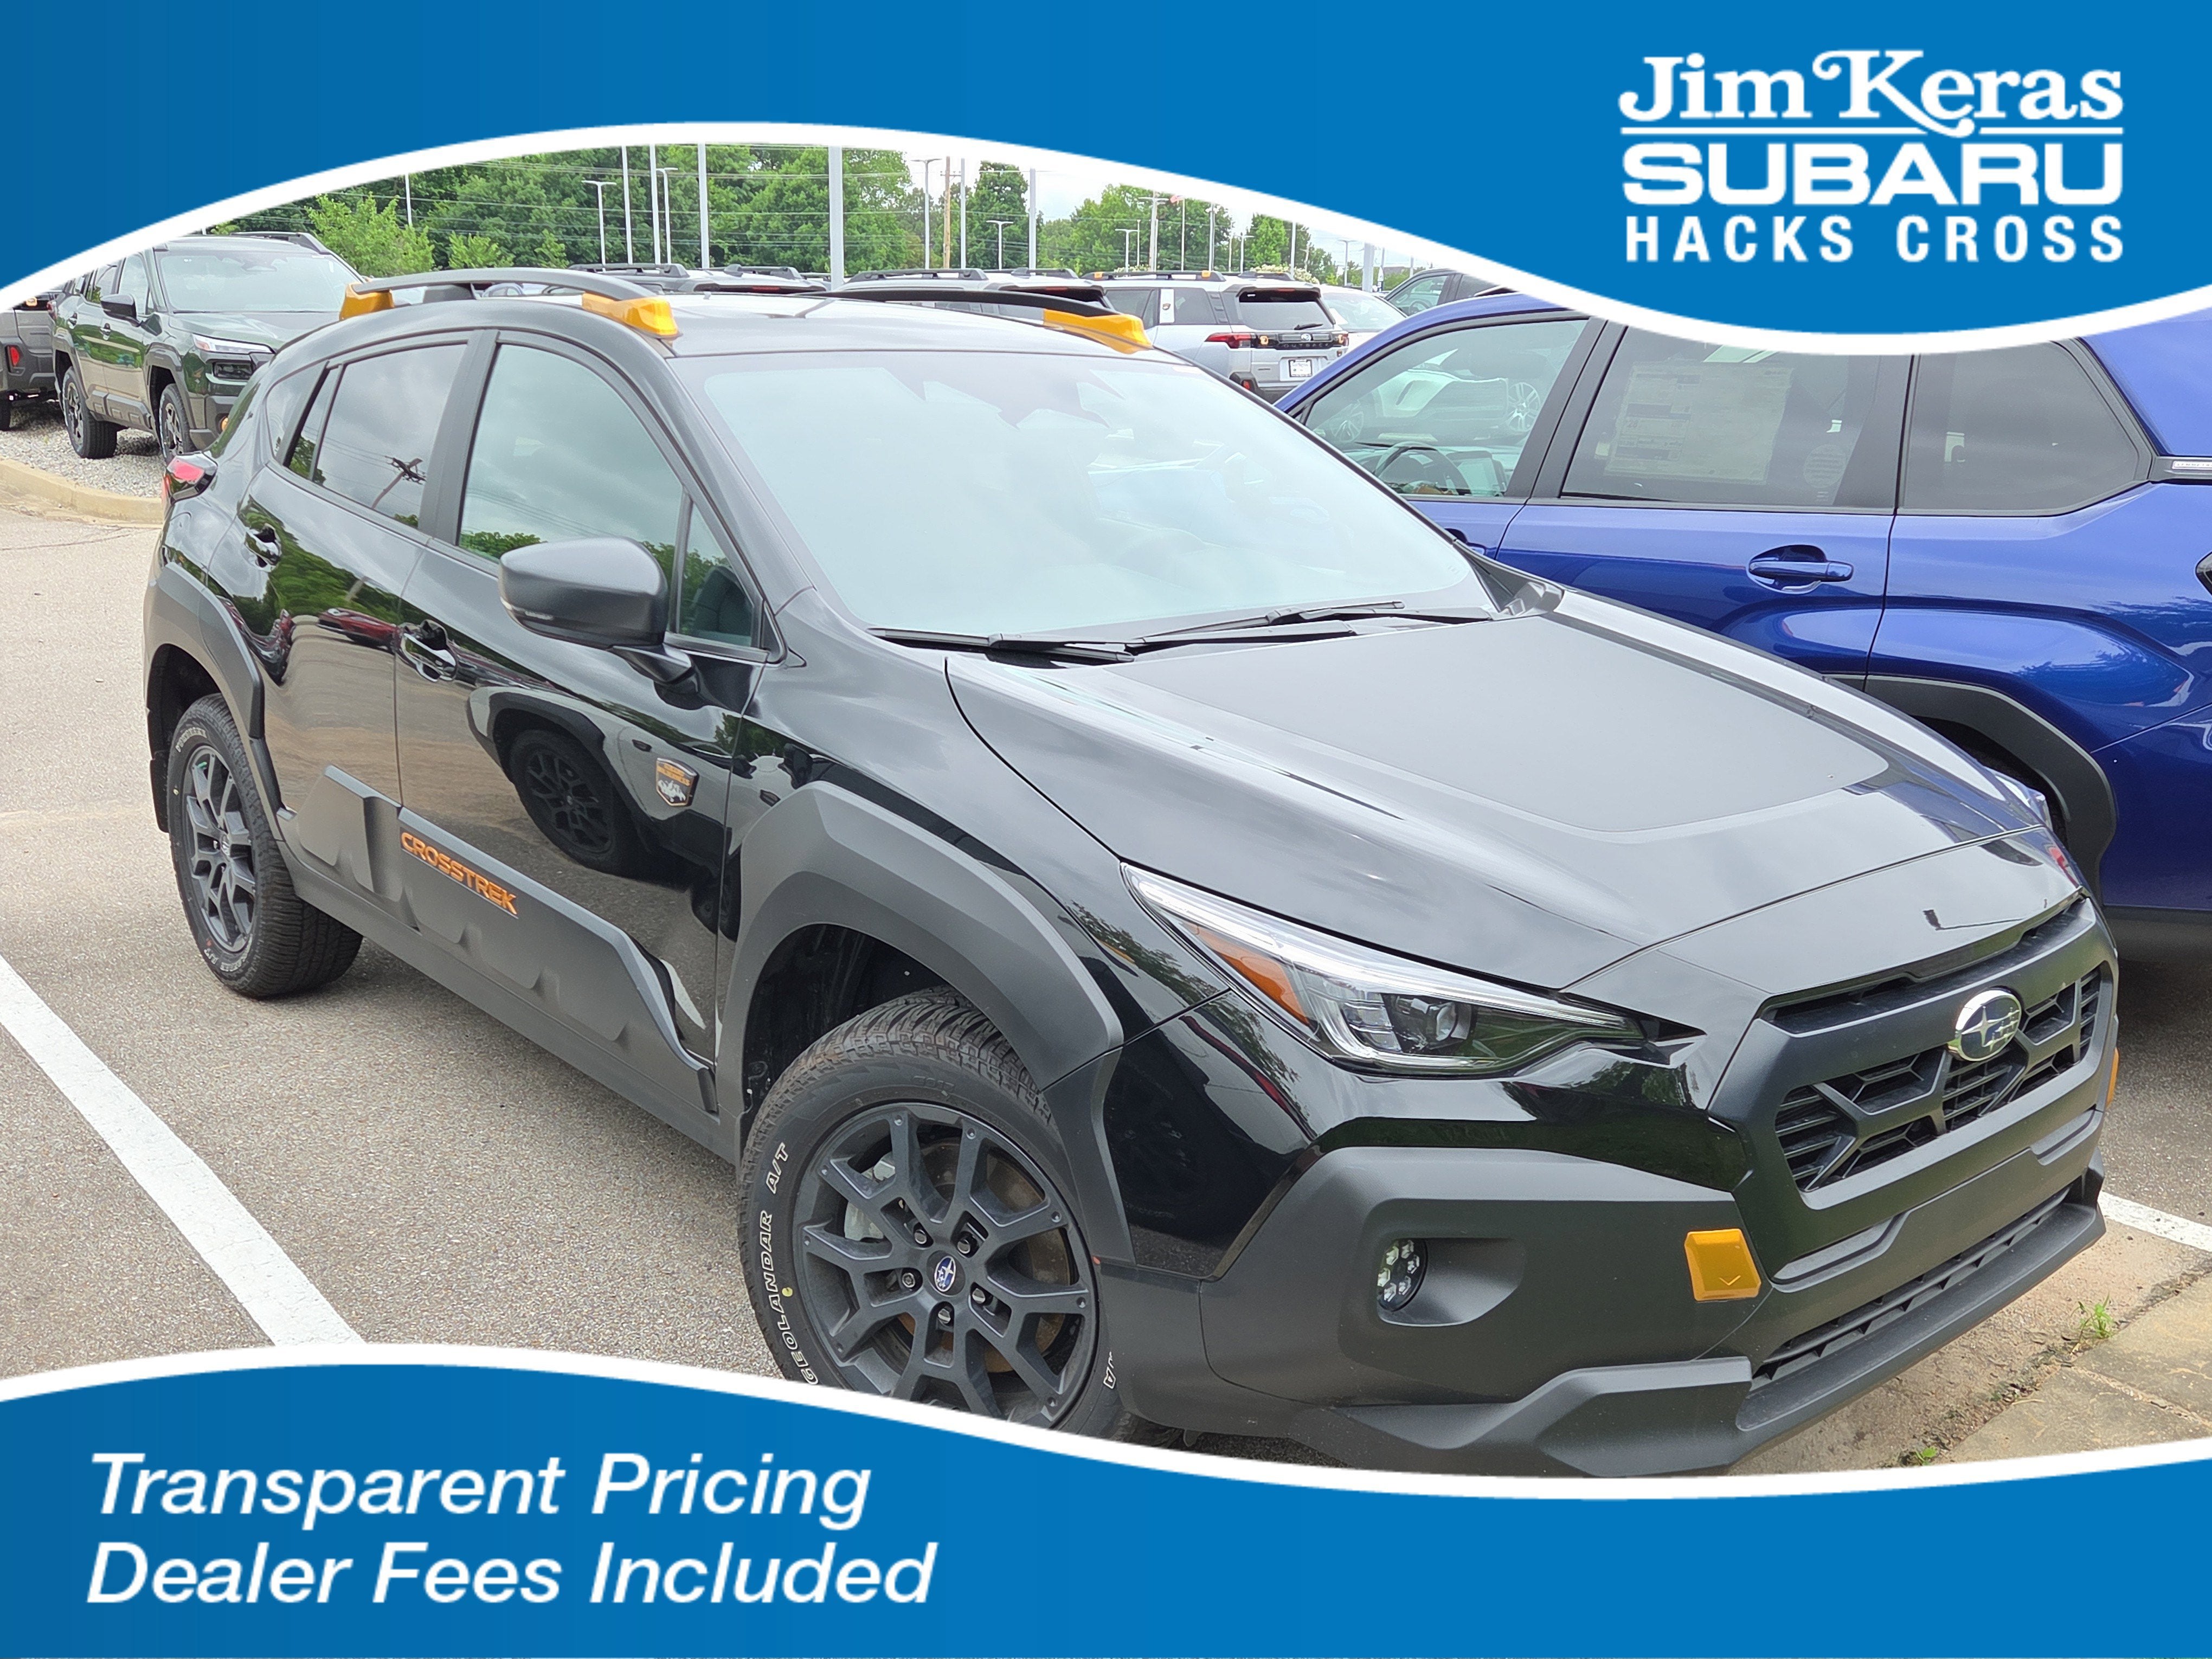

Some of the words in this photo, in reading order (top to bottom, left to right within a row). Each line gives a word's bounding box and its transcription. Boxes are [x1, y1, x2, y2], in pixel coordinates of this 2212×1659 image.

[401, 832, 517, 915] CROSSTREK
[766, 1142, 789, 1194] A/T
[760, 1210, 819, 1385] GEOLANDAR
